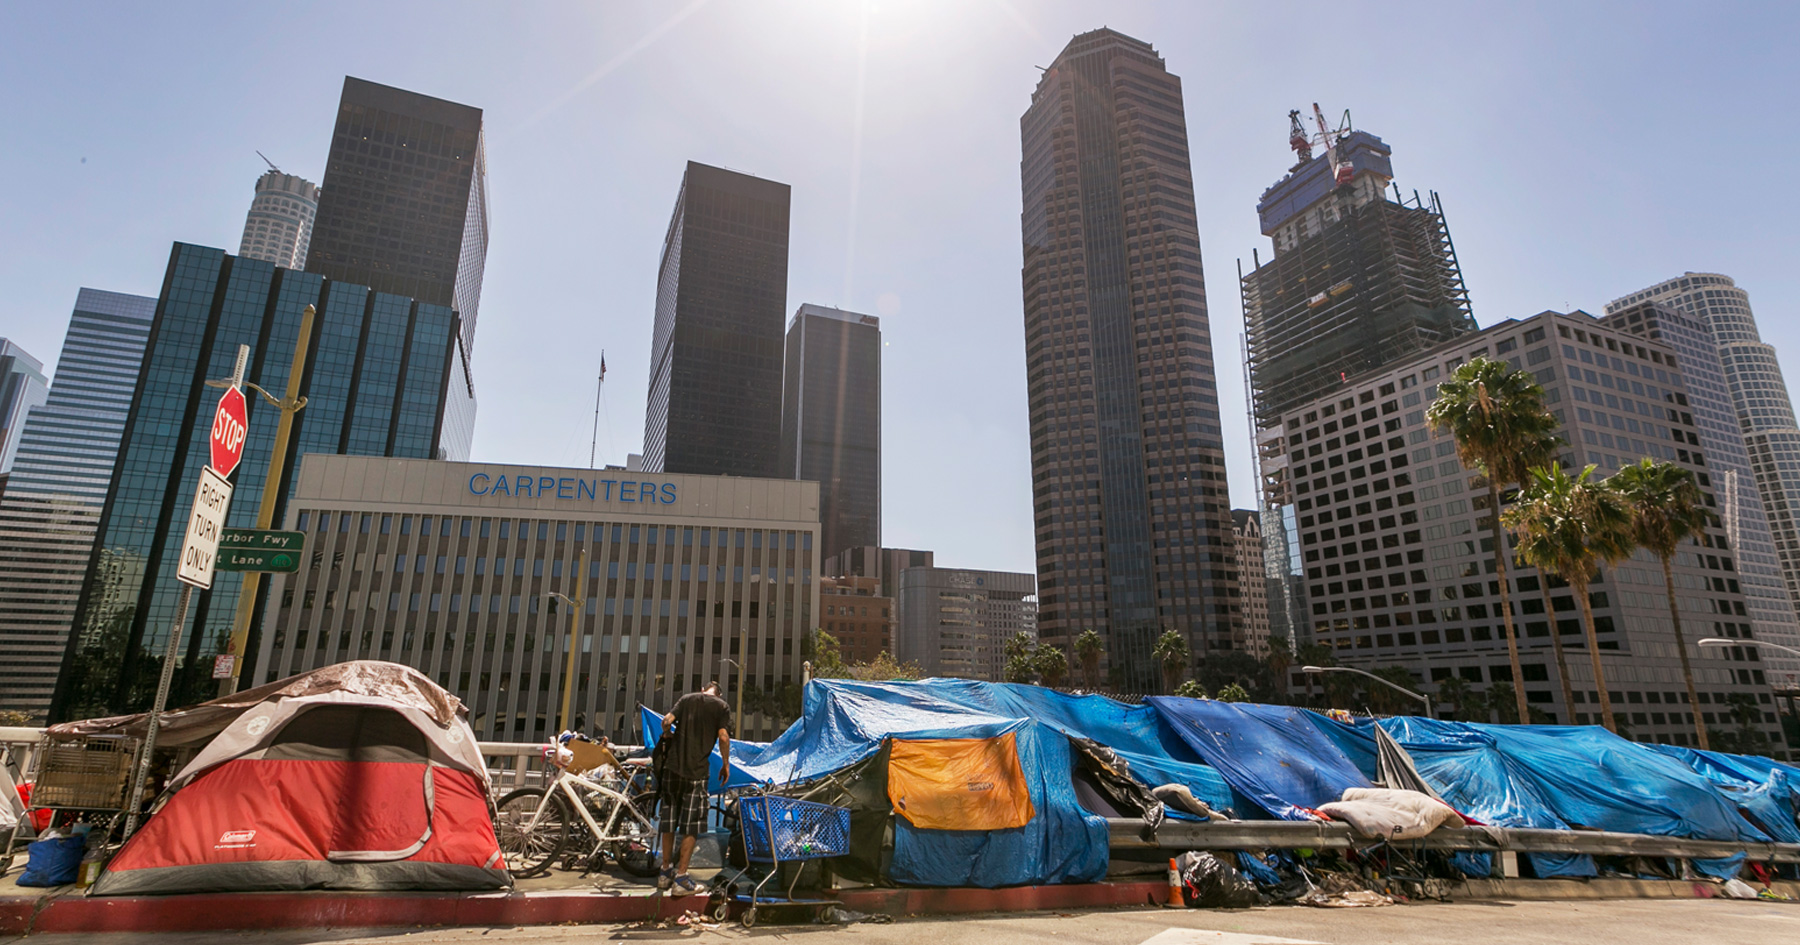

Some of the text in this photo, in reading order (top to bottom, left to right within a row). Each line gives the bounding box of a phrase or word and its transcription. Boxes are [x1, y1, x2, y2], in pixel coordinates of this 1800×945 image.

[214, 408, 245, 454] STOP
[201, 483, 226, 514] RIGHT
[469, 473, 677, 504] CARPENTERS
[194, 514, 219, 543] TURN
[220, 534, 290, 547] arbor Fwy
[187, 546, 212, 572] ONLY
[231, 555, 263, 565] Lane
